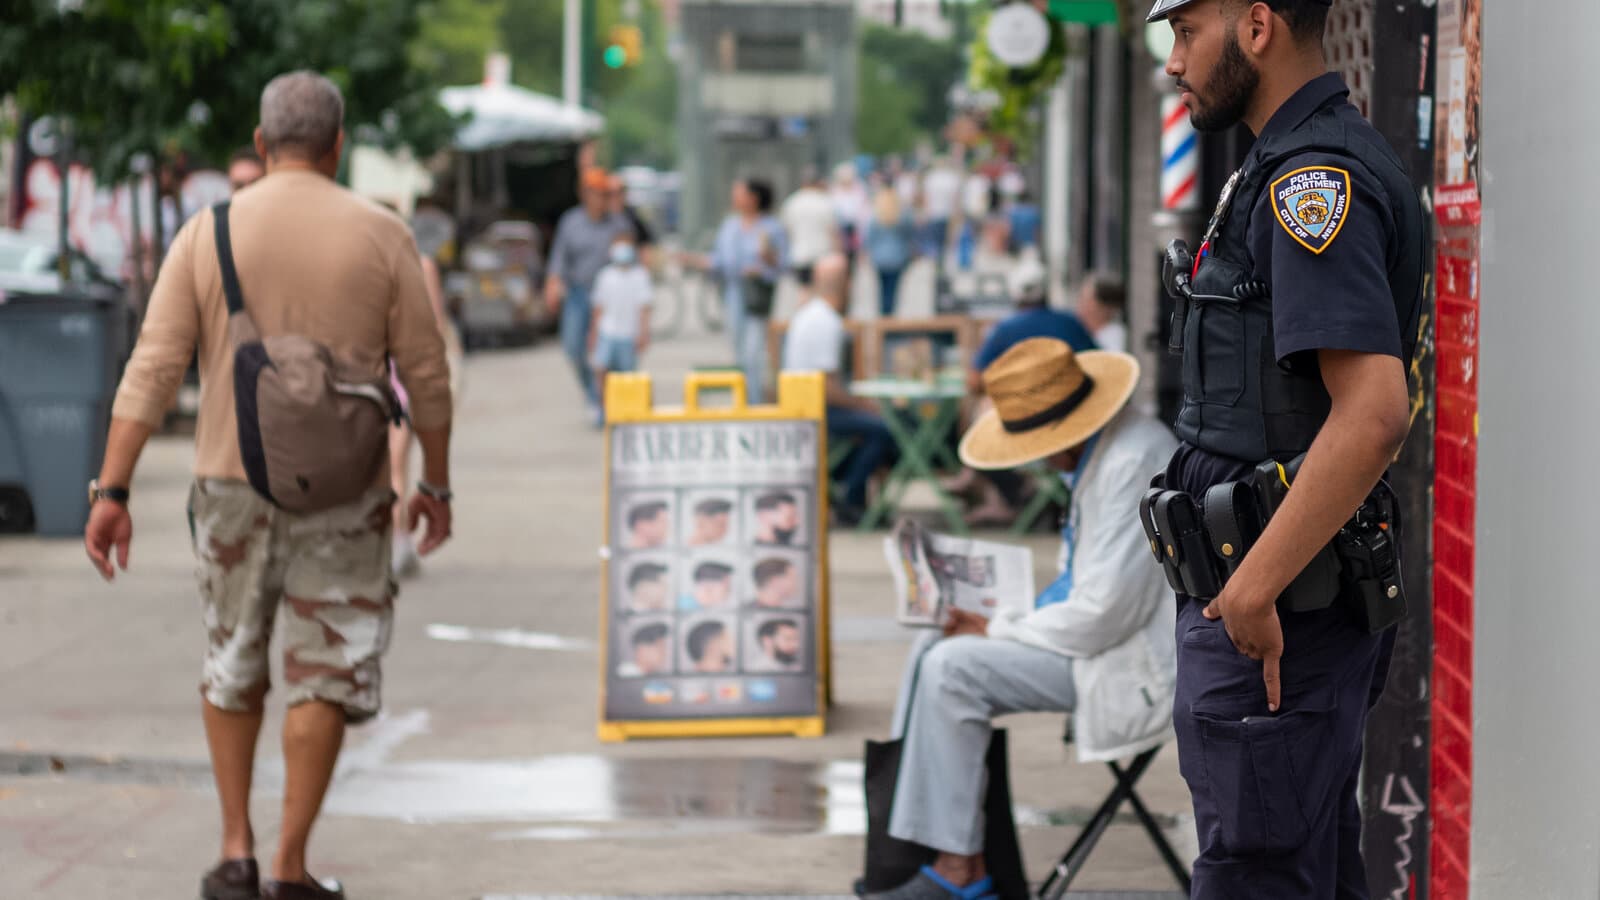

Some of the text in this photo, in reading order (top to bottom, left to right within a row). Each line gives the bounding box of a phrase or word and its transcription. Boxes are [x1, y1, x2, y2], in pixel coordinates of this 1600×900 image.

[1279, 180, 1342, 200] DEPARTMENT
[1290, 172, 1328, 185] POLICE
[1280, 209, 1308, 238] CITY OF
[1321, 194, 1346, 240] NEW YORK
[621, 427, 812, 464] BARBER SHOP
